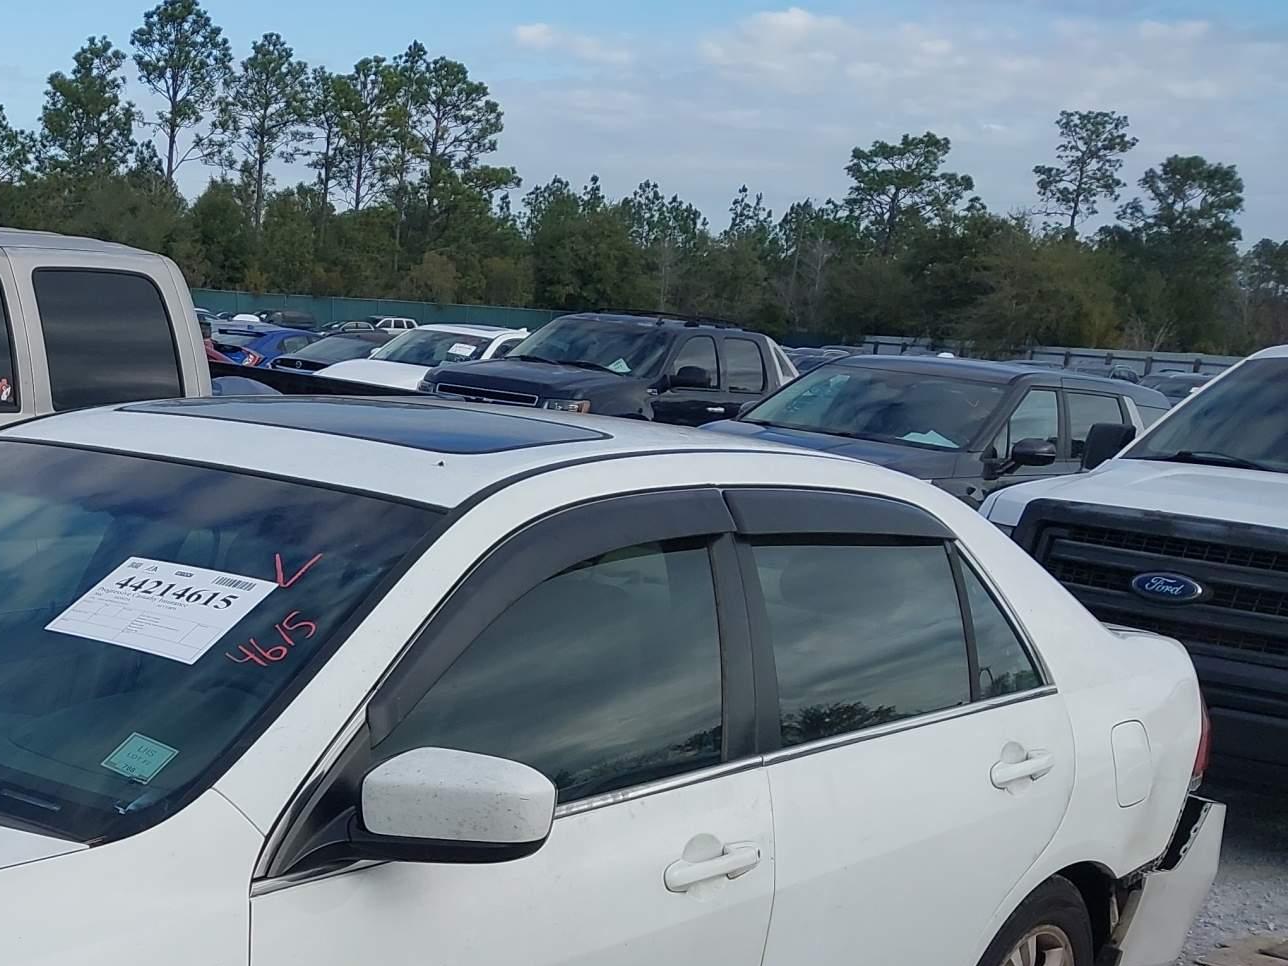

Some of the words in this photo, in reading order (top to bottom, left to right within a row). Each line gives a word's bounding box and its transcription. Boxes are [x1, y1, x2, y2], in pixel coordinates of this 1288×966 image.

[115, 575, 240, 610] 44214615
[1144, 576, 1185, 595] Ford
[225, 610, 316, 666] 4615
